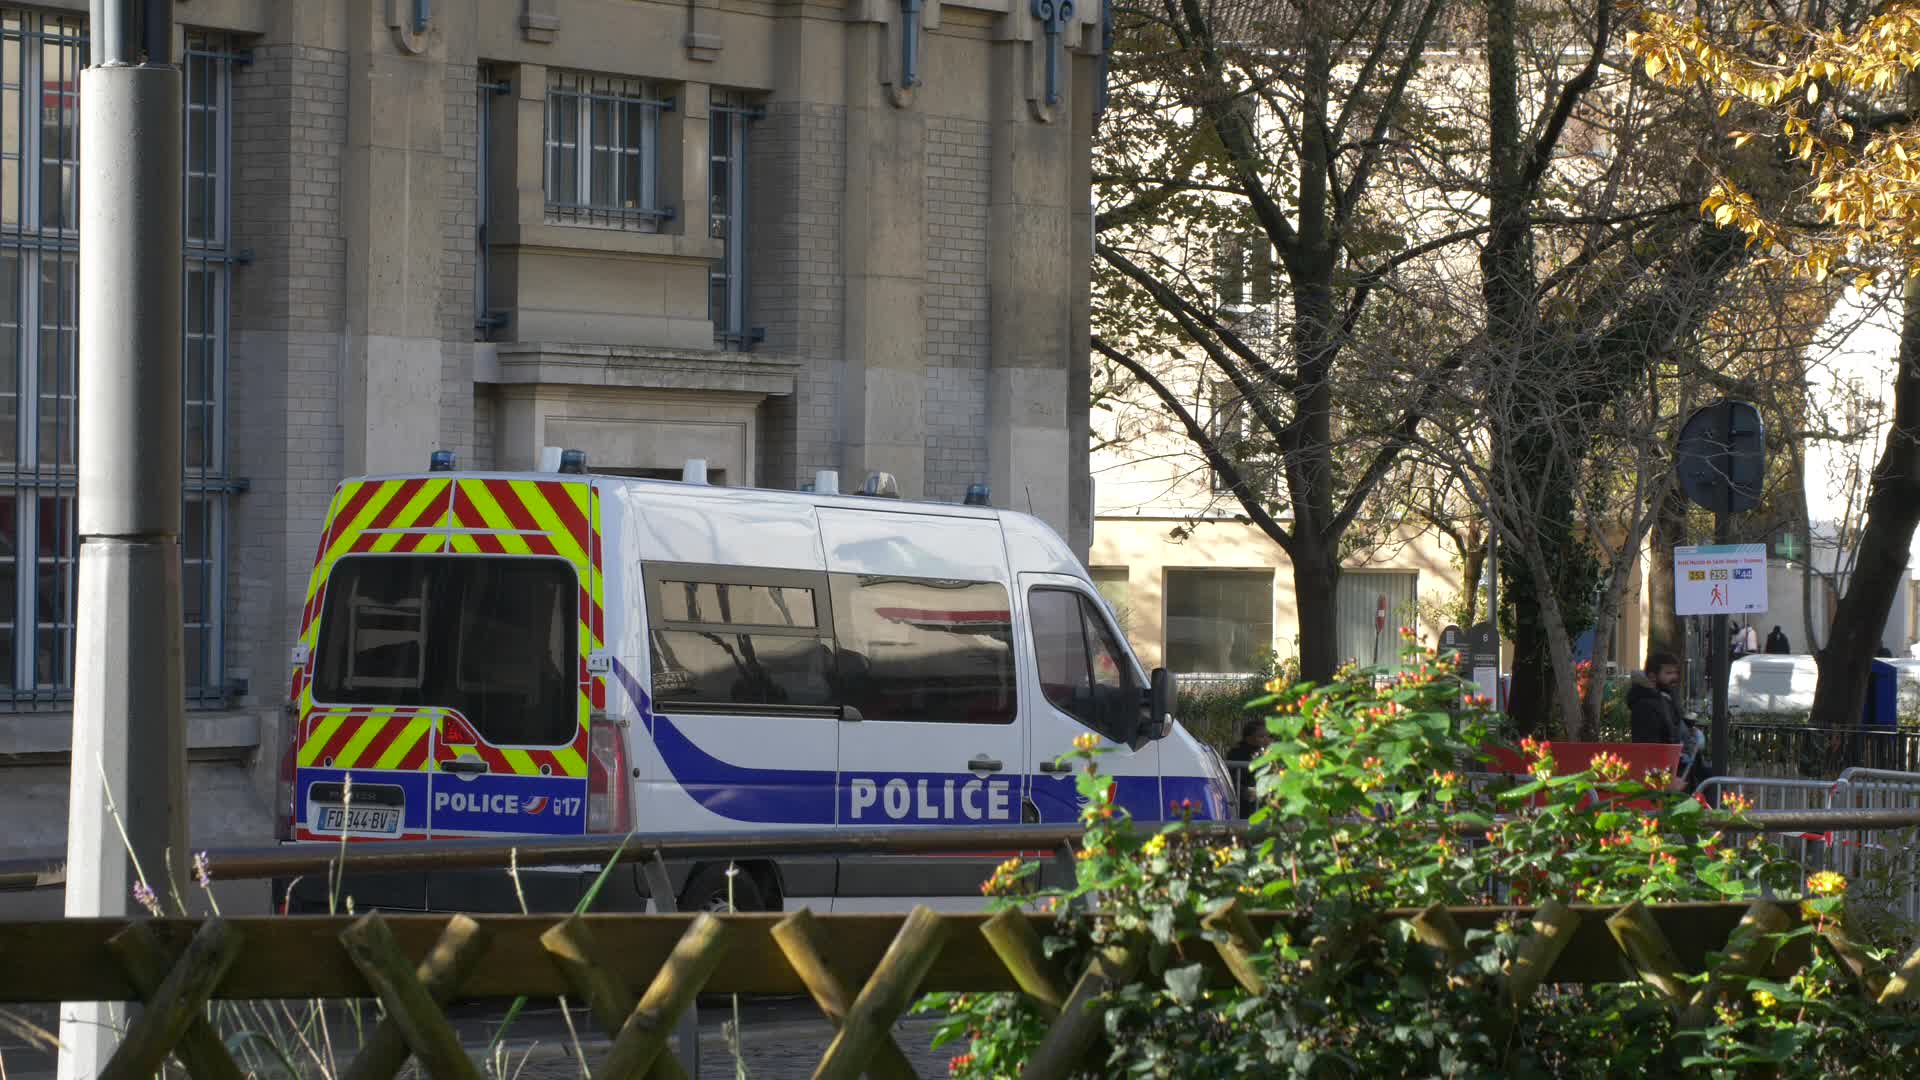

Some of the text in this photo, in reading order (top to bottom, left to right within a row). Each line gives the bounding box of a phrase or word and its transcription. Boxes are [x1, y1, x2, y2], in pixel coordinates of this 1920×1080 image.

[434, 791, 582, 816] POLICE 17
[851, 778, 1009, 820] POLICE
